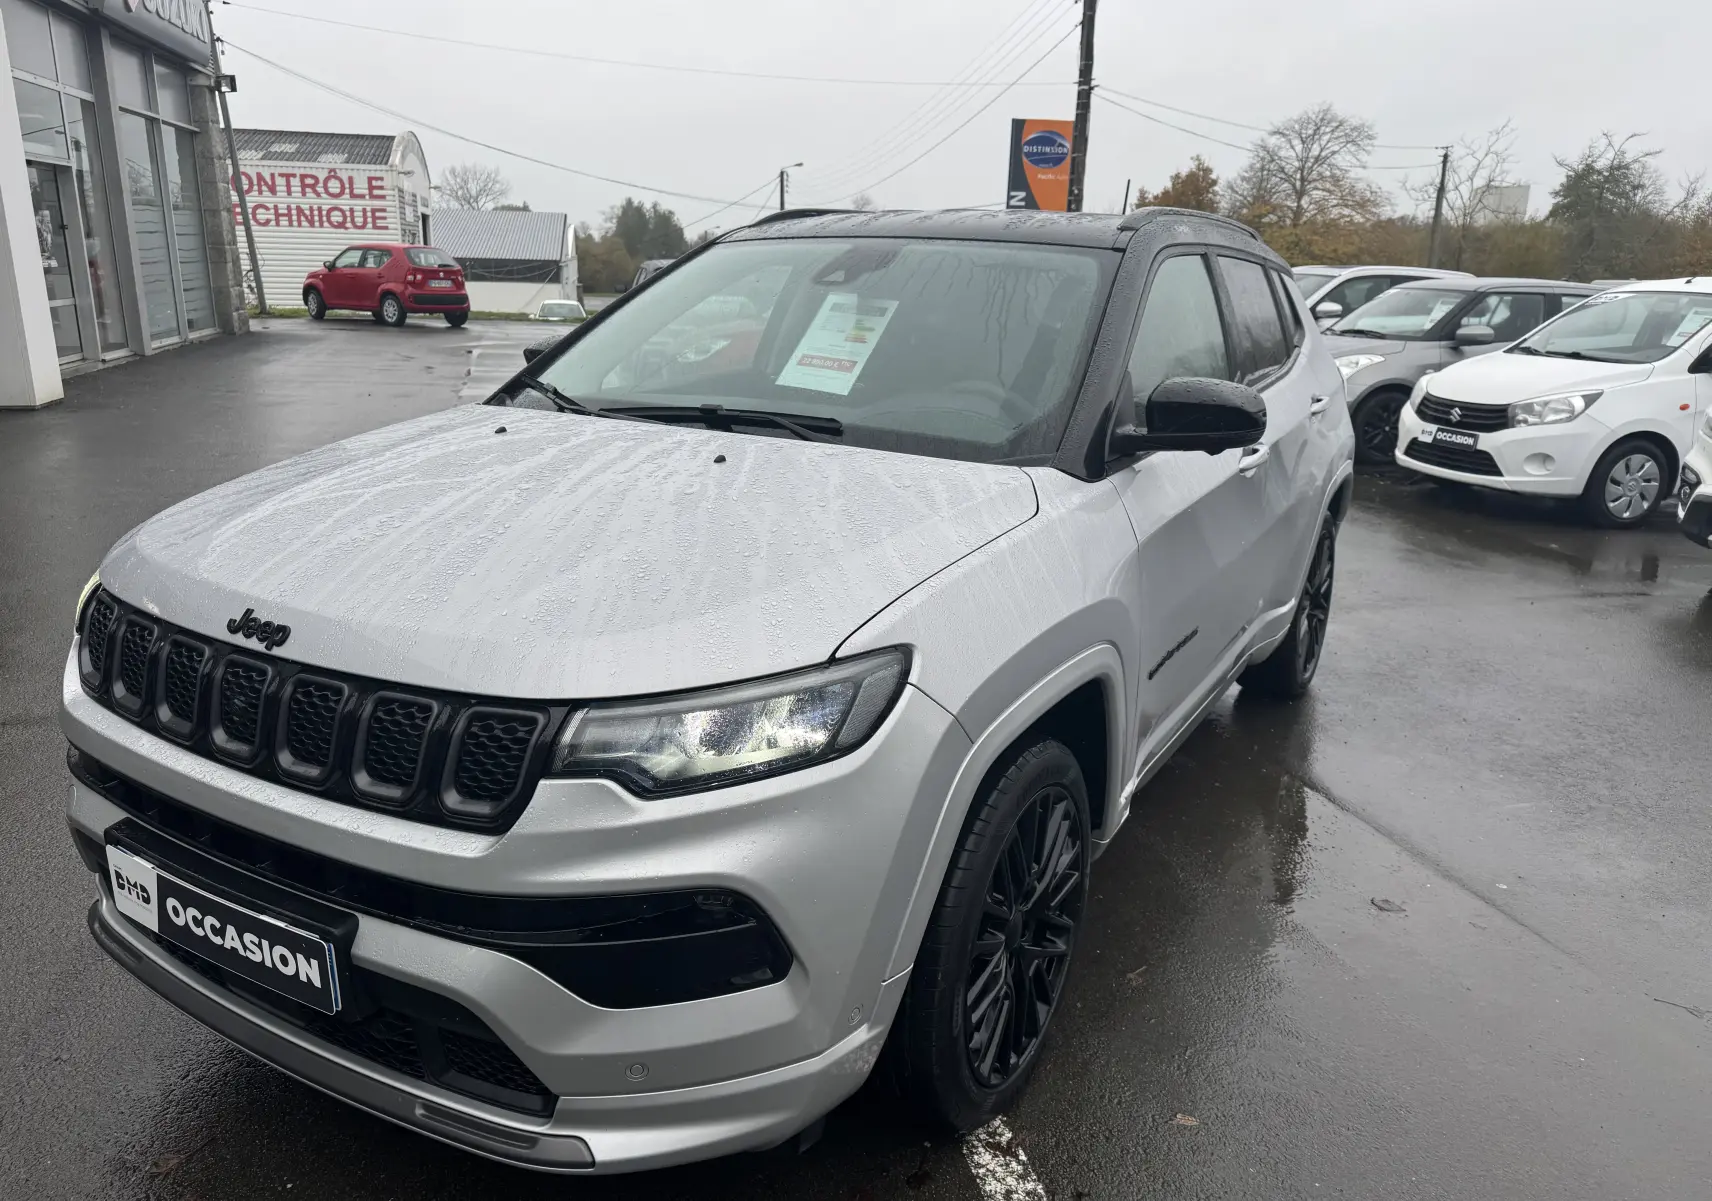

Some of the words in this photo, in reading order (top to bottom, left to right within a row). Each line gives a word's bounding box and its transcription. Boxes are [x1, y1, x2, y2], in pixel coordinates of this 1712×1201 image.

[1436, 431, 1475, 446] OCCASION
[226, 608, 291, 651] Jeep
[166, 897, 322, 988] OCCASION
